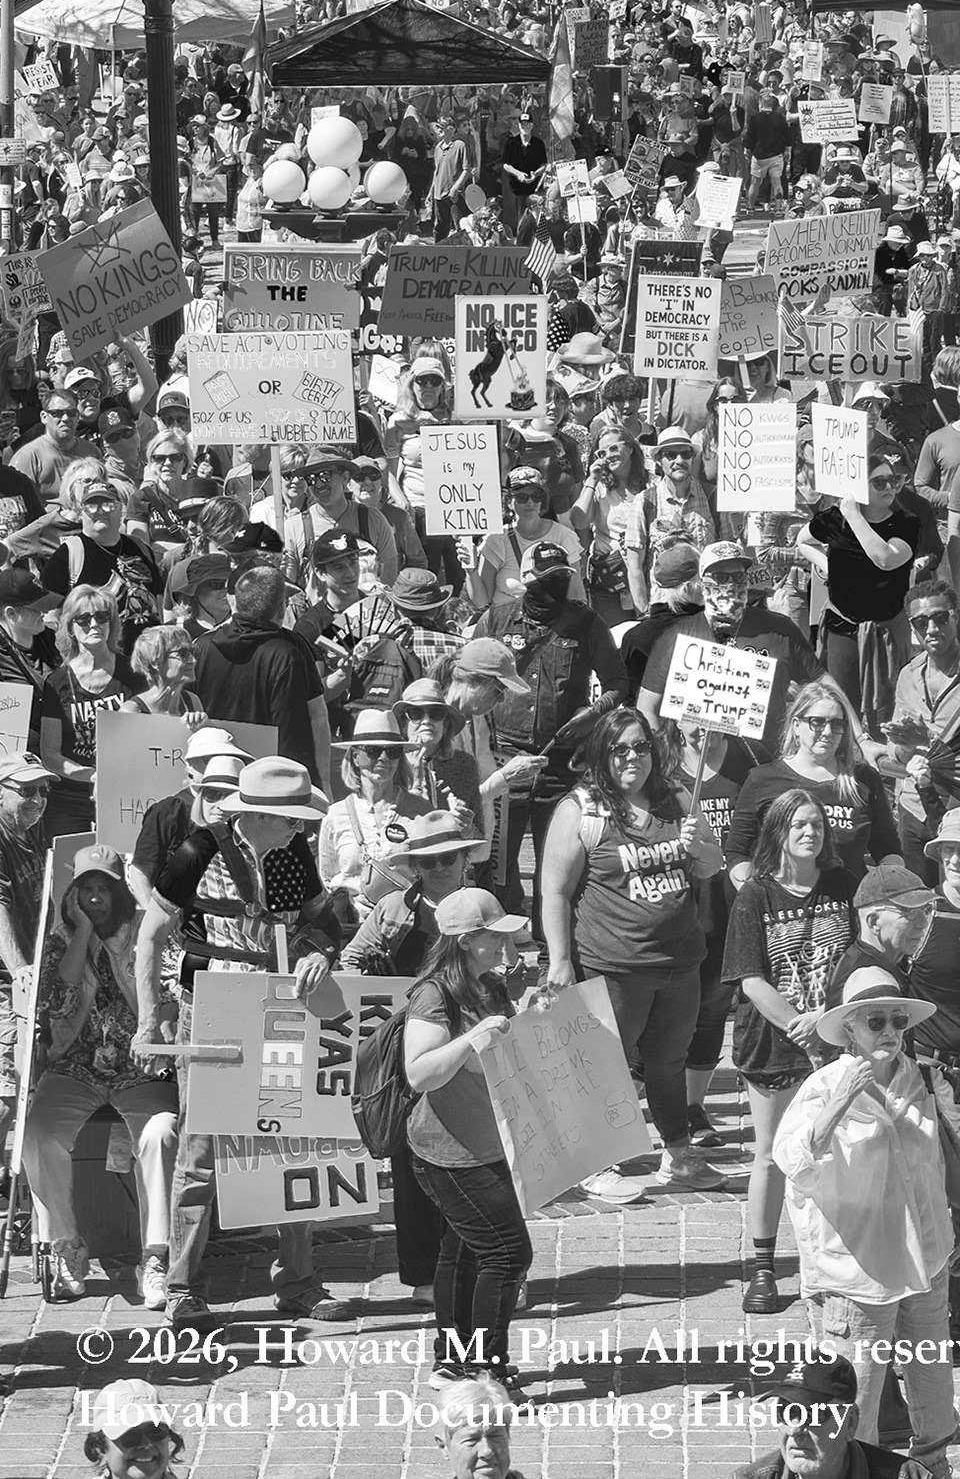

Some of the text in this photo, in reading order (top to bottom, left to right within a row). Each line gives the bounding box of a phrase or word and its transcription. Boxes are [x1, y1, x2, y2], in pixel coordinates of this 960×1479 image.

[431, 0, 445, 7] NO
[24, 62, 52, 78] RESIST
[32, 74, 55, 89] FEAR
[772, 219, 828, 247] WHEN
[768, 236, 876, 267] BECOMES NORMAL
[229, 254, 363, 283] BRING BACK
[390, 249, 530, 280] TRUMP KILLING
[780, 256, 869, 279] COMPASSION
[56, 284, 97, 325] NO
[95, 242, 178, 306] KINGS
[266, 284, 309, 302] THE
[402, 278, 516, 299] DEMOCRACY
[646, 283, 713, 299] THERE'S NO
[682, 299, 695, 312] IN
[729, 282, 778, 308] Belongs
[72, 273, 182, 347] SAVE DEMOCRACY
[424, 308, 446, 323] FREE
[465, 303, 538, 329] NO ICE
[644, 311, 711, 326] DEMOCRACY
[187, 333, 349, 353] SAVE ACT VOTING
[465, 329, 486, 353] IN
[645, 331, 709, 343] BUT THERE IS A
[783, 321, 912, 354] STRIKE
[656, 342, 696, 358] DICK
[643, 358, 709, 371] IN DICTATOR.
[782, 352, 913, 379] ICE OUT
[301, 371, 341, 399] BIRTH
[192, 409, 352, 425] 50% OF US TOOK
[723, 407, 753, 428] NO
[271, 424, 318, 441] HUBBIES
[322, 424, 355, 441] NAME
[825, 418, 860, 439] TRUMP
[428, 432, 487, 452] JESUS
[723, 430, 753, 449] NO
[442, 462, 475, 477] is my
[723, 451, 794, 471] NO AUTOCRATS
[438, 483, 484, 504] ONLY
[723, 473, 794, 493] NO FASCISTS
[443, 507, 488, 530] KING
[683, 643, 751, 679] Christian
[69, 693, 125, 724] NASTY
[703, 698, 748, 721] Trump
[715, 797, 730, 810] MY
[838, 818, 854, 830] US
[256, 975, 308, 1133] QUEENS
[316, 1008, 355, 1098] YAS
[486, 1011, 603, 1089] ICE BELONGS
[499, 1048, 593, 1125] IN A DRINK
[538, 1068, 601, 1129] IN THE
[532, 1124, 581, 1182] STREETS
[282, 1162, 369, 1212] NO
